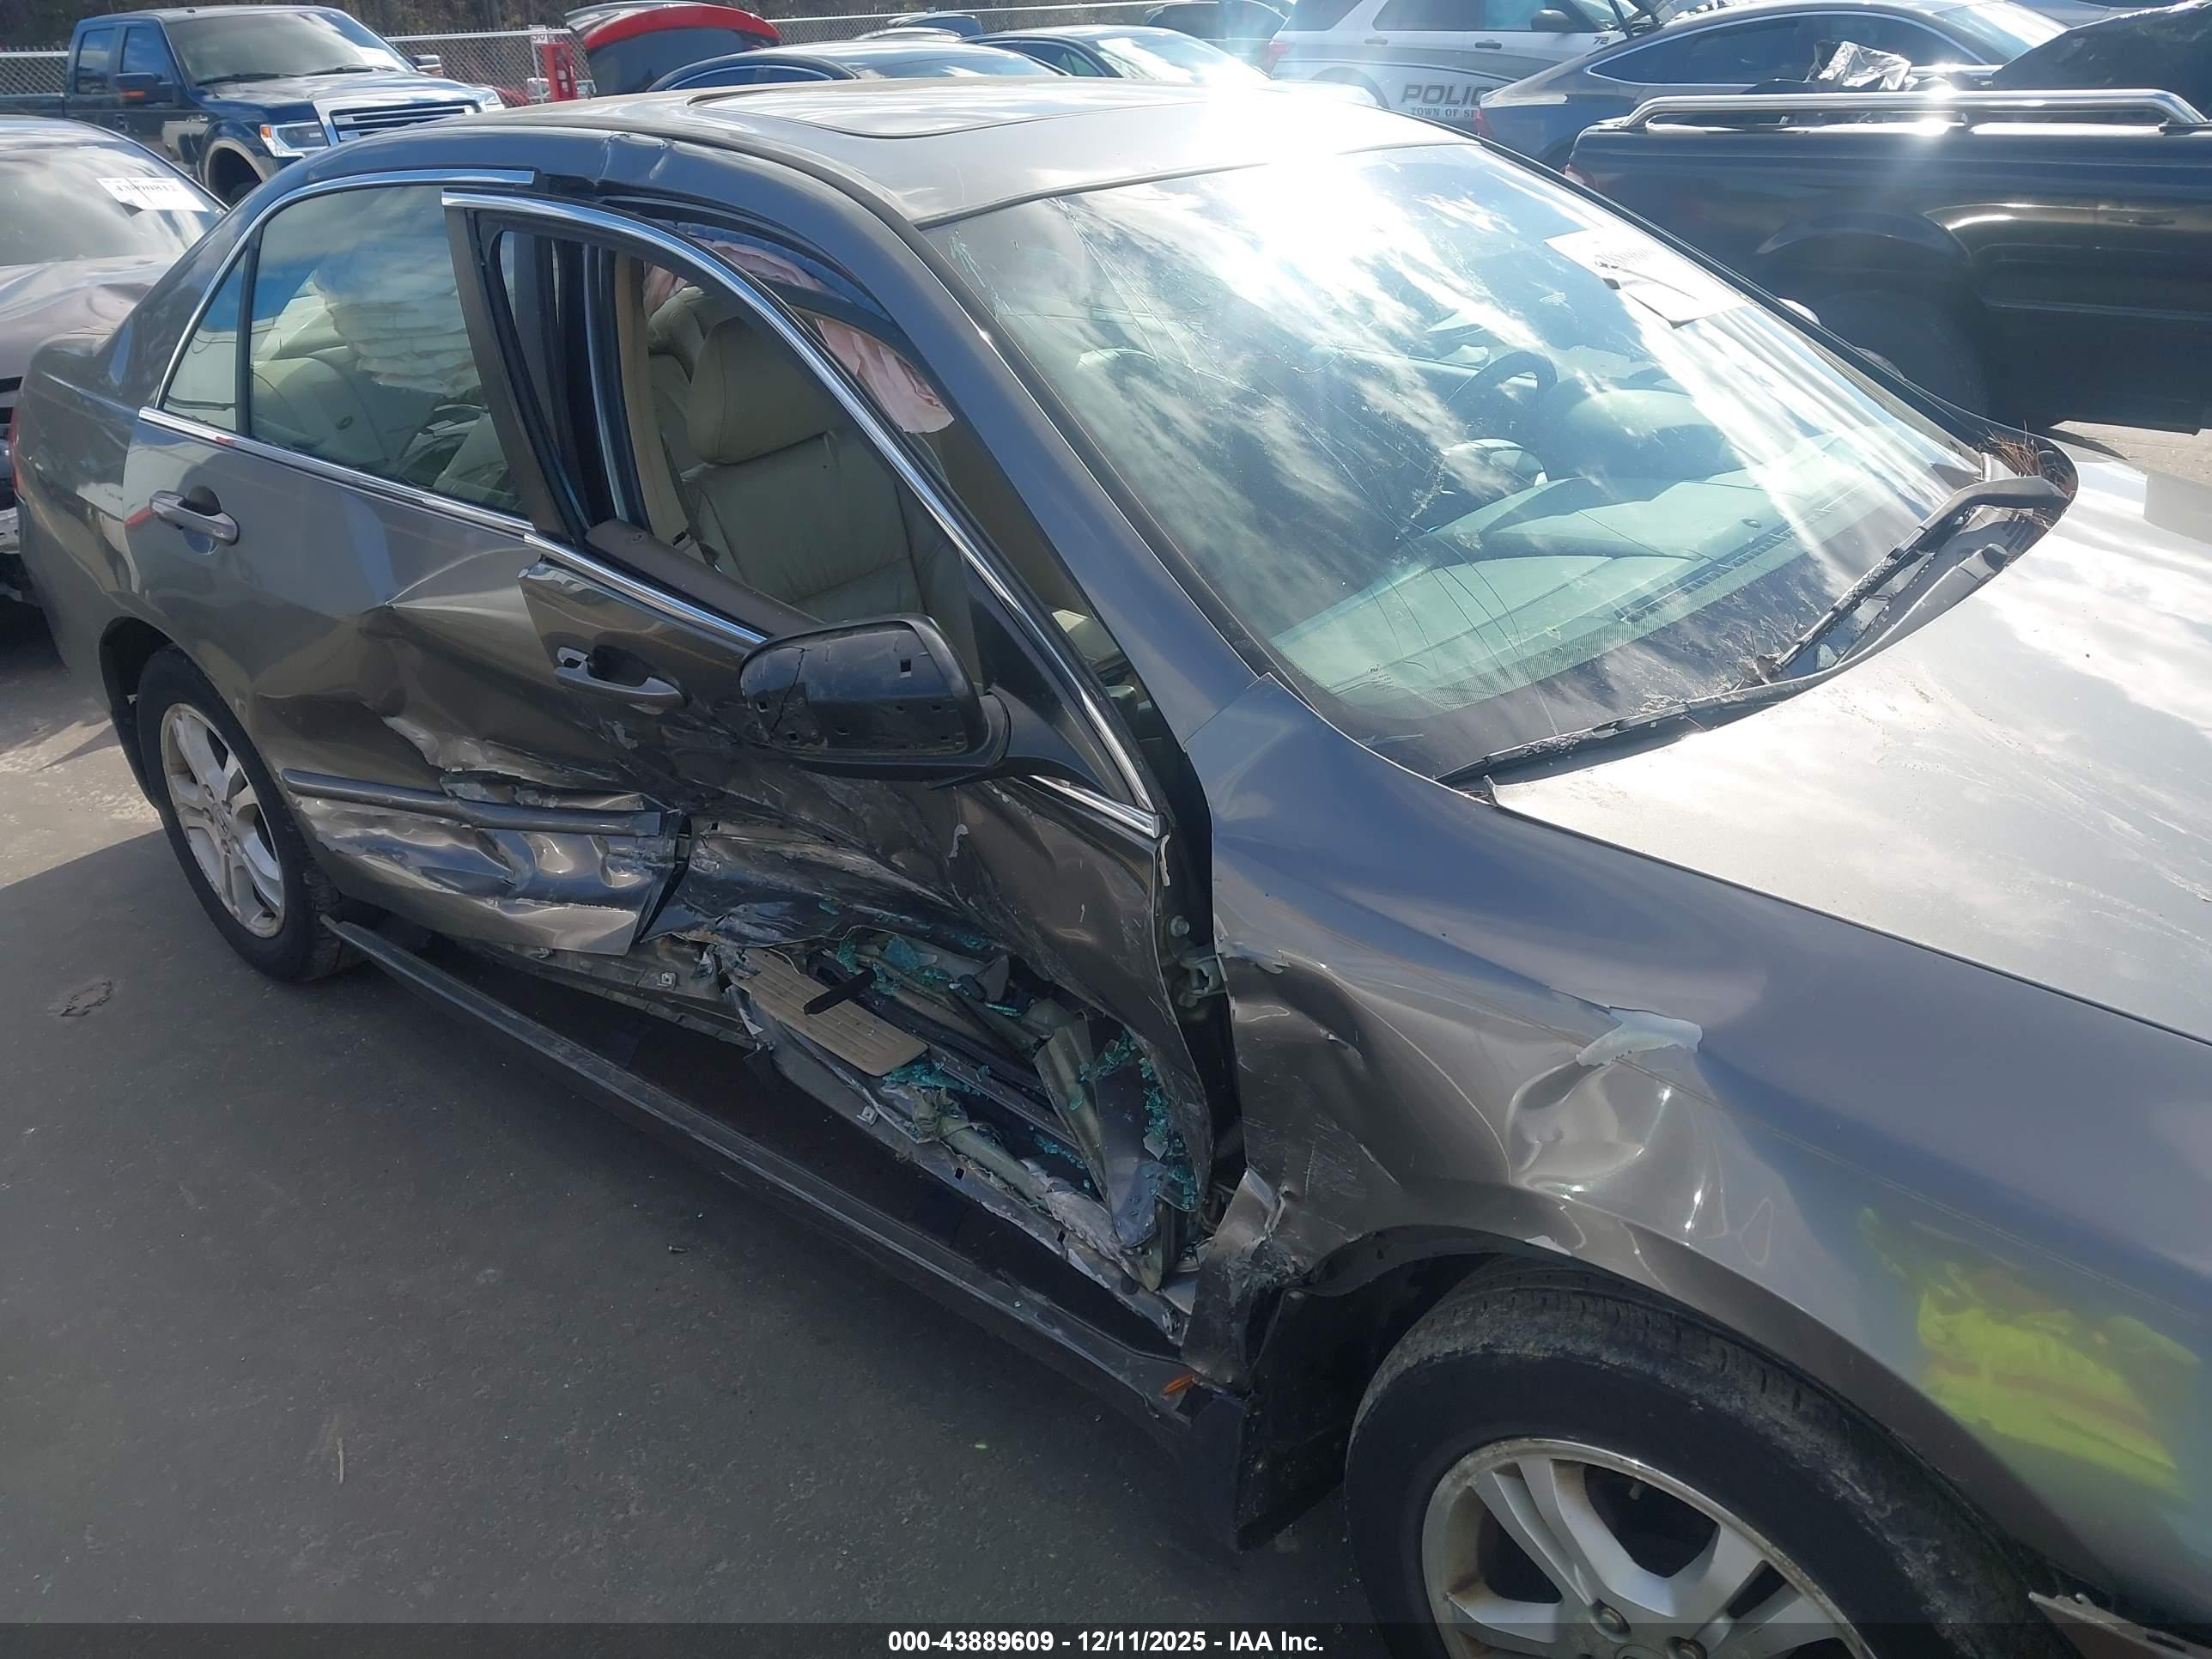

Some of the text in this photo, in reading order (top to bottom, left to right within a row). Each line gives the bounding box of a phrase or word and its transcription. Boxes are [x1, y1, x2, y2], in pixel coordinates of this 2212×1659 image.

[1401, 84, 1499, 106] POLIC
[1411, 106, 1441, 117] TOWN
[1444, 107, 1460, 118] OF
